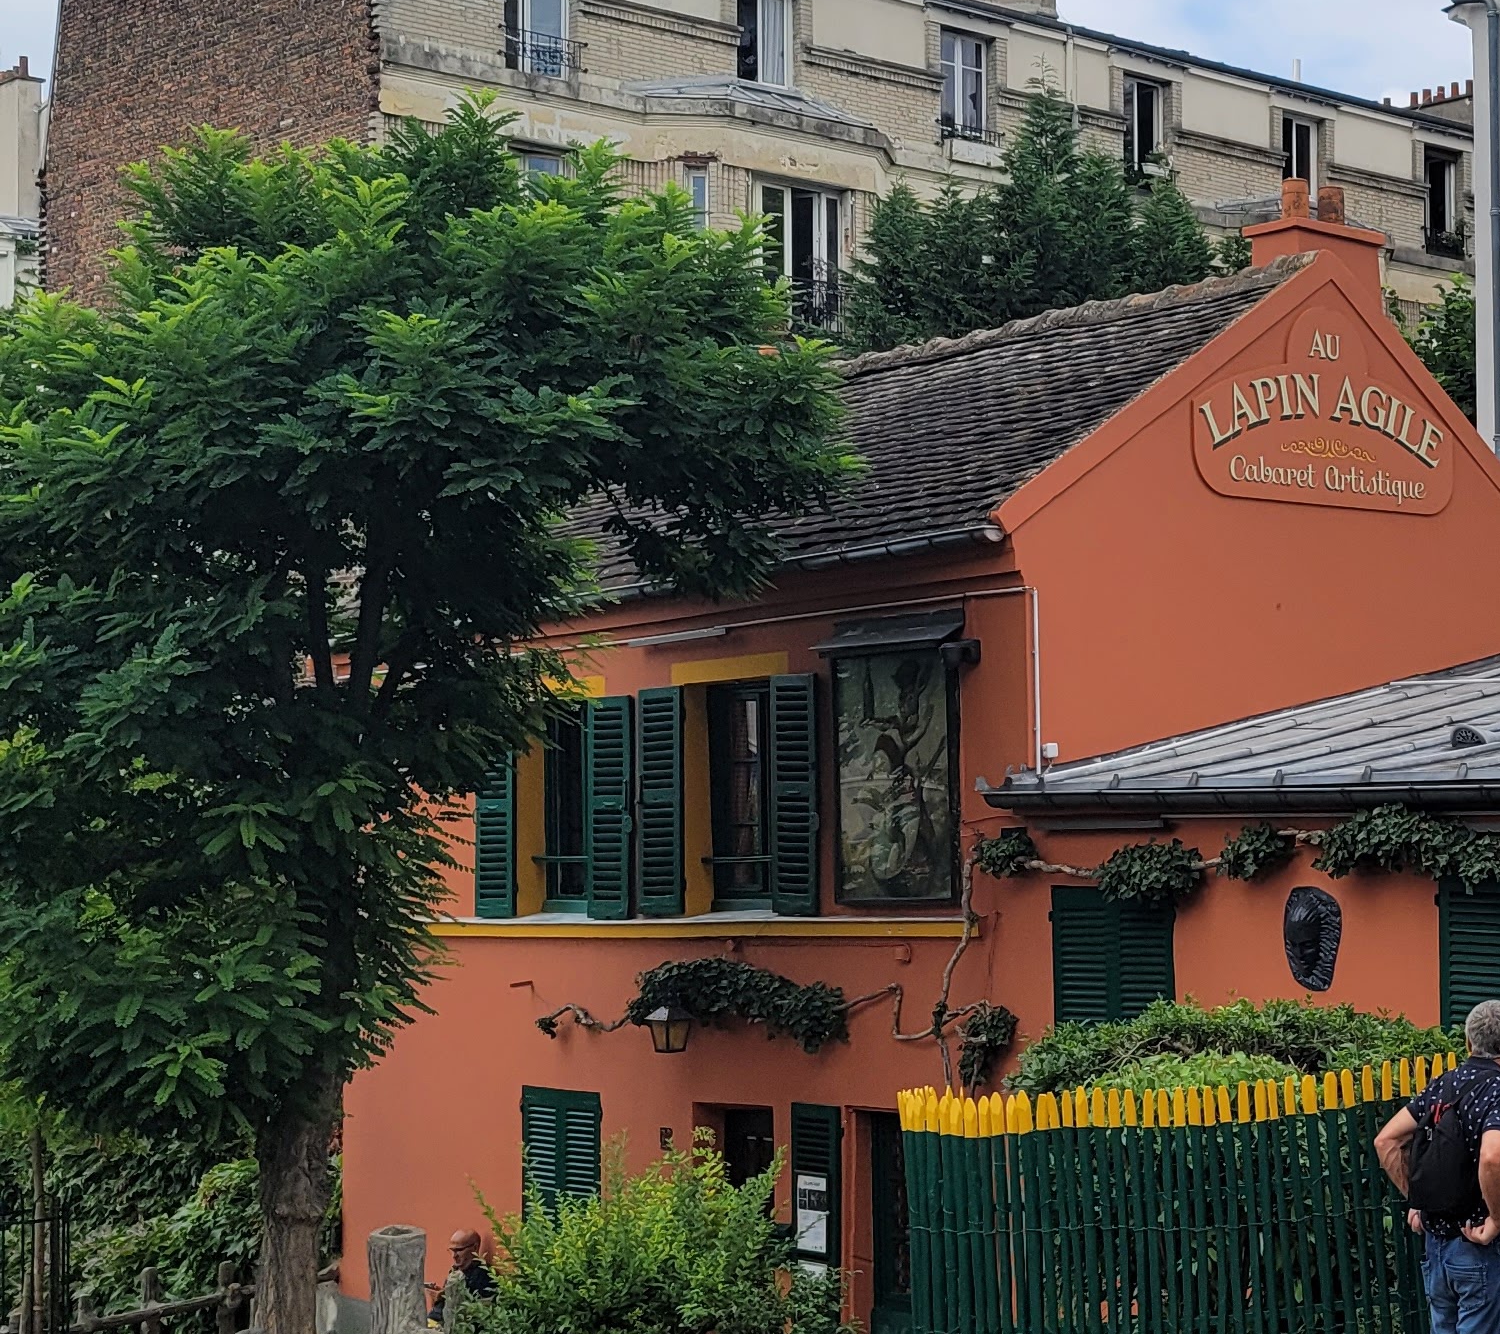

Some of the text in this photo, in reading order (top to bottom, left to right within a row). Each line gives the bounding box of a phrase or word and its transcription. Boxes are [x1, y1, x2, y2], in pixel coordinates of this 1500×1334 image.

[1308, 329, 1340, 361] AU
[1199, 373, 1444, 469] LAPIN AGILE
[1229, 455, 1316, 489] Cabaret
